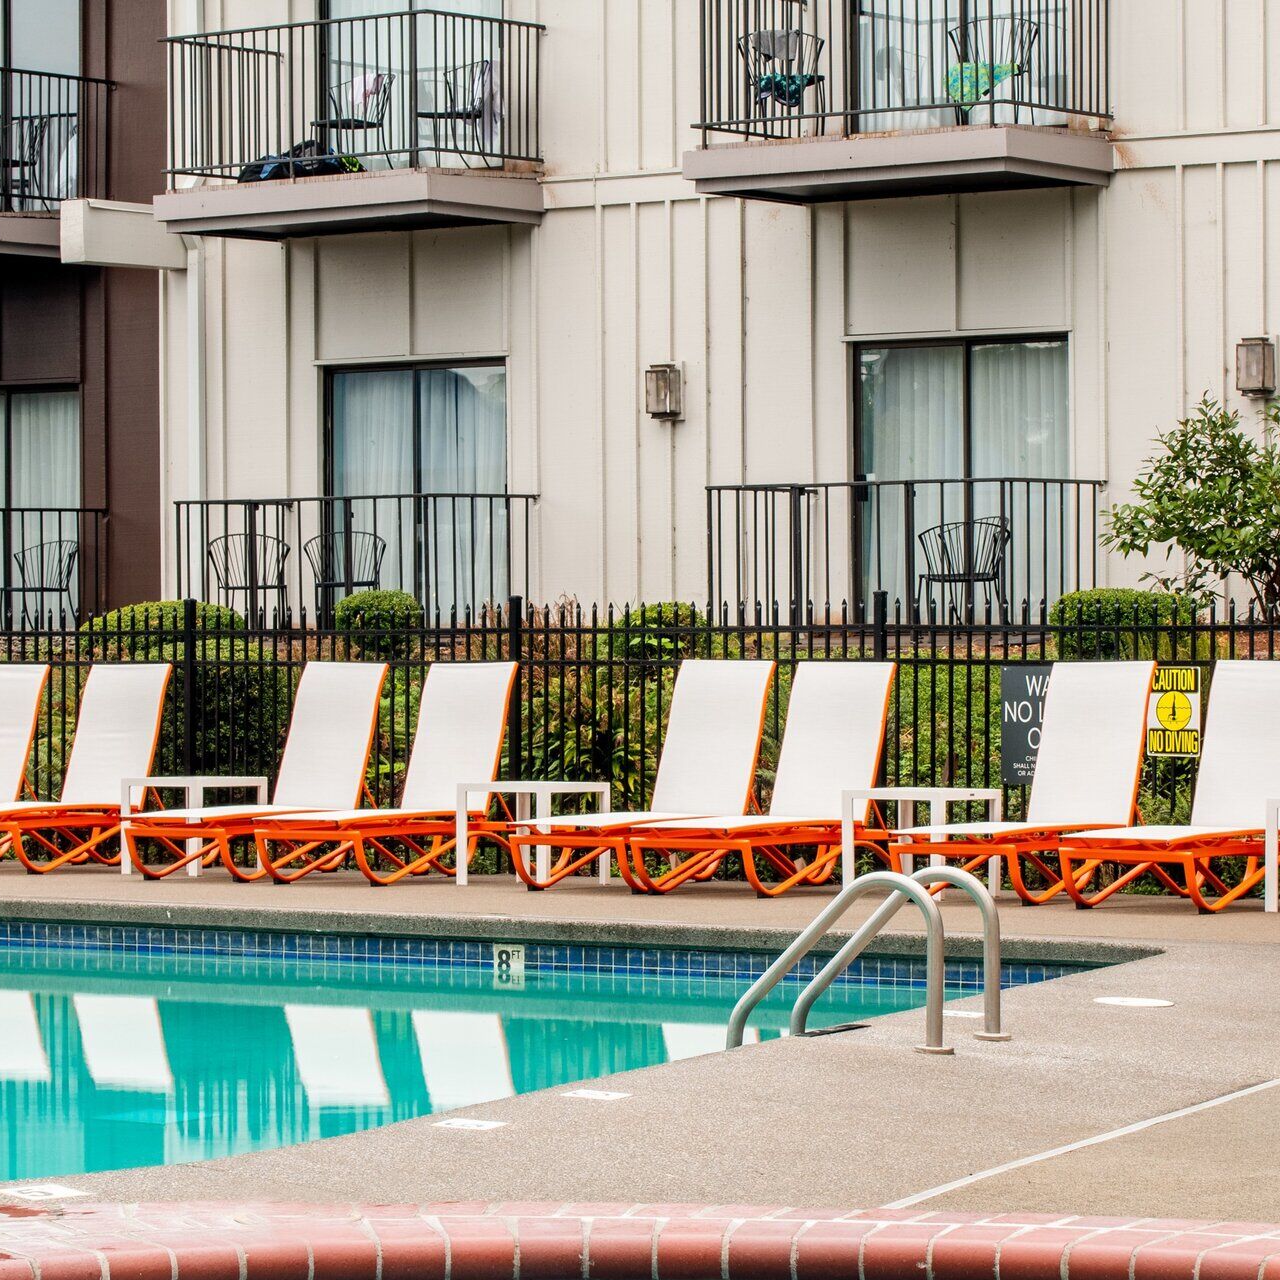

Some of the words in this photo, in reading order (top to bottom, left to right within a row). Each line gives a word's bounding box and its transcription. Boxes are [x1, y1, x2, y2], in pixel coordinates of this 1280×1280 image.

[1152, 669, 1195, 691] CAUTION
[1004, 701, 1032, 723] NO
[1149, 730, 1164, 752] NO
[1165, 731, 1198, 753] DIVING
[511, 950, 521, 959] FT
